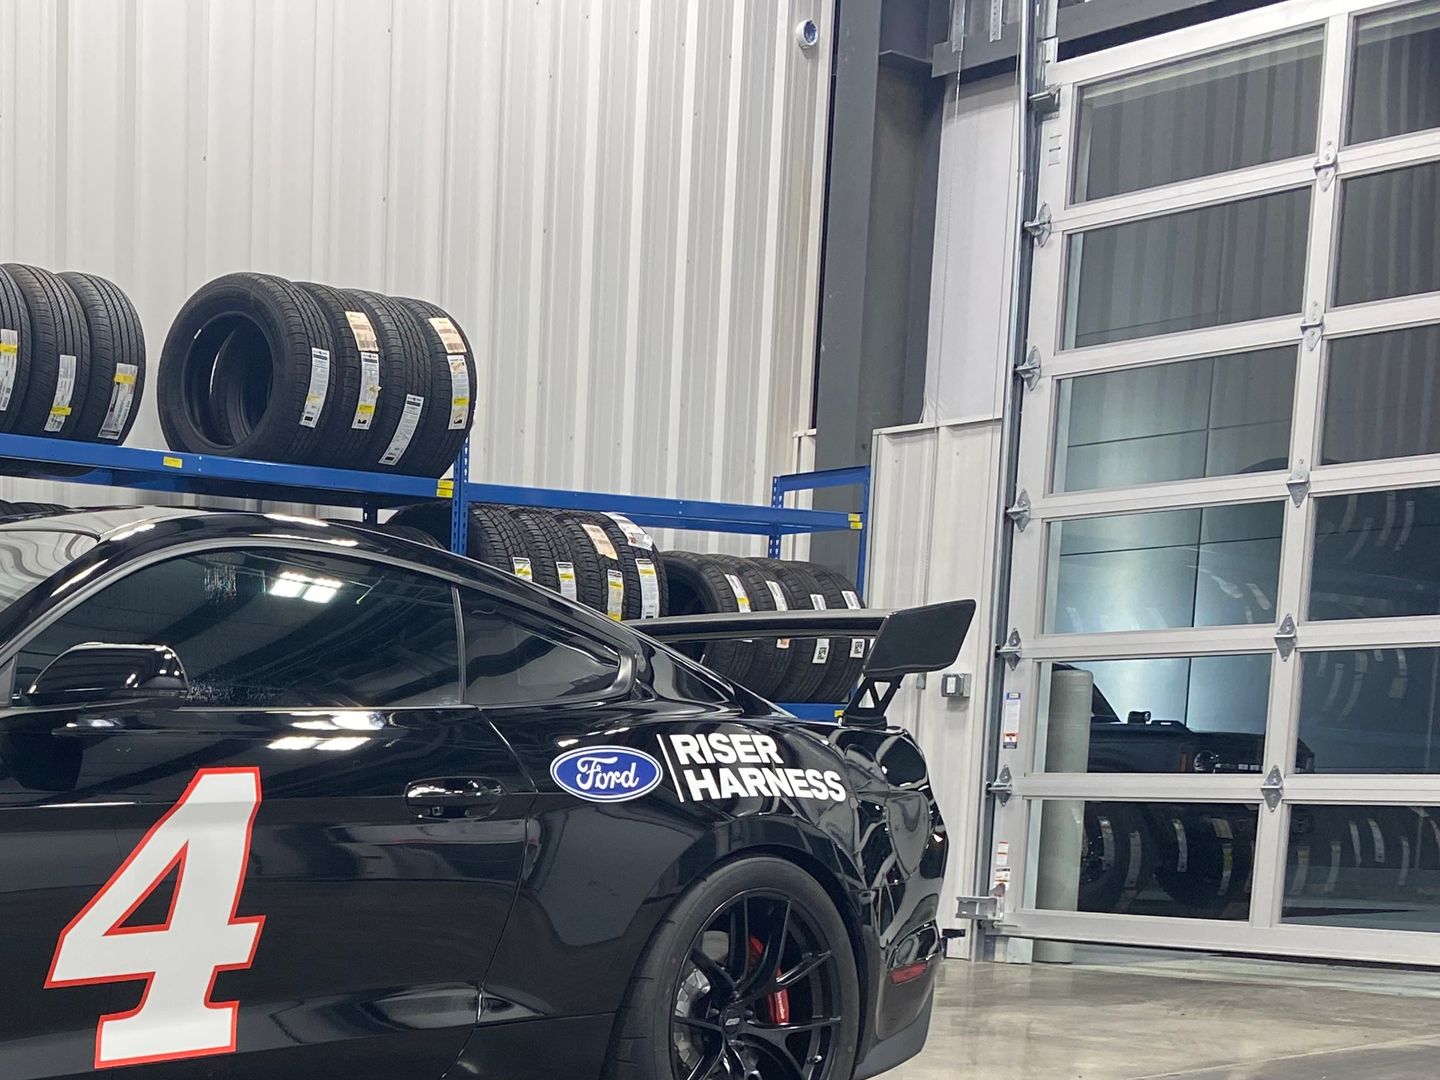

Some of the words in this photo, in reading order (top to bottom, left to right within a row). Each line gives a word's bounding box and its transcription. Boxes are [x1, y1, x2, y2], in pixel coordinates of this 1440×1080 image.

[669, 733, 785, 765] RISER
[575, 756, 640, 790] Ford
[683, 767, 847, 802] HARNESS
[44, 766, 267, 1069] 4
